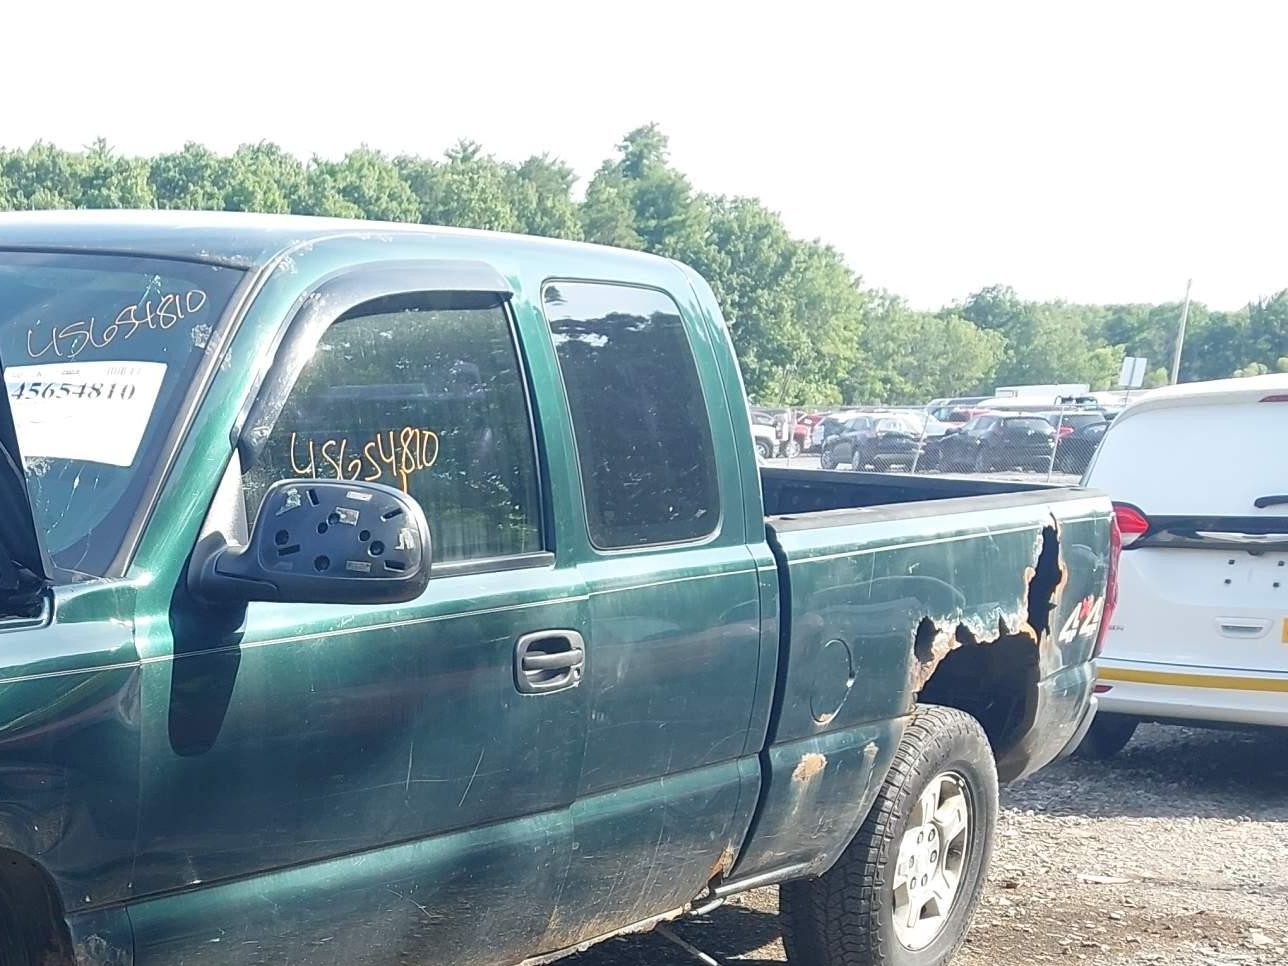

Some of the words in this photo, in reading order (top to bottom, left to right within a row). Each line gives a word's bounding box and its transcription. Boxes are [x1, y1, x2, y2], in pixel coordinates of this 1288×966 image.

[27, 289, 207, 358] 45654810
[10, 381, 136, 400] 45654810
[290, 426, 439, 481] 45654810
